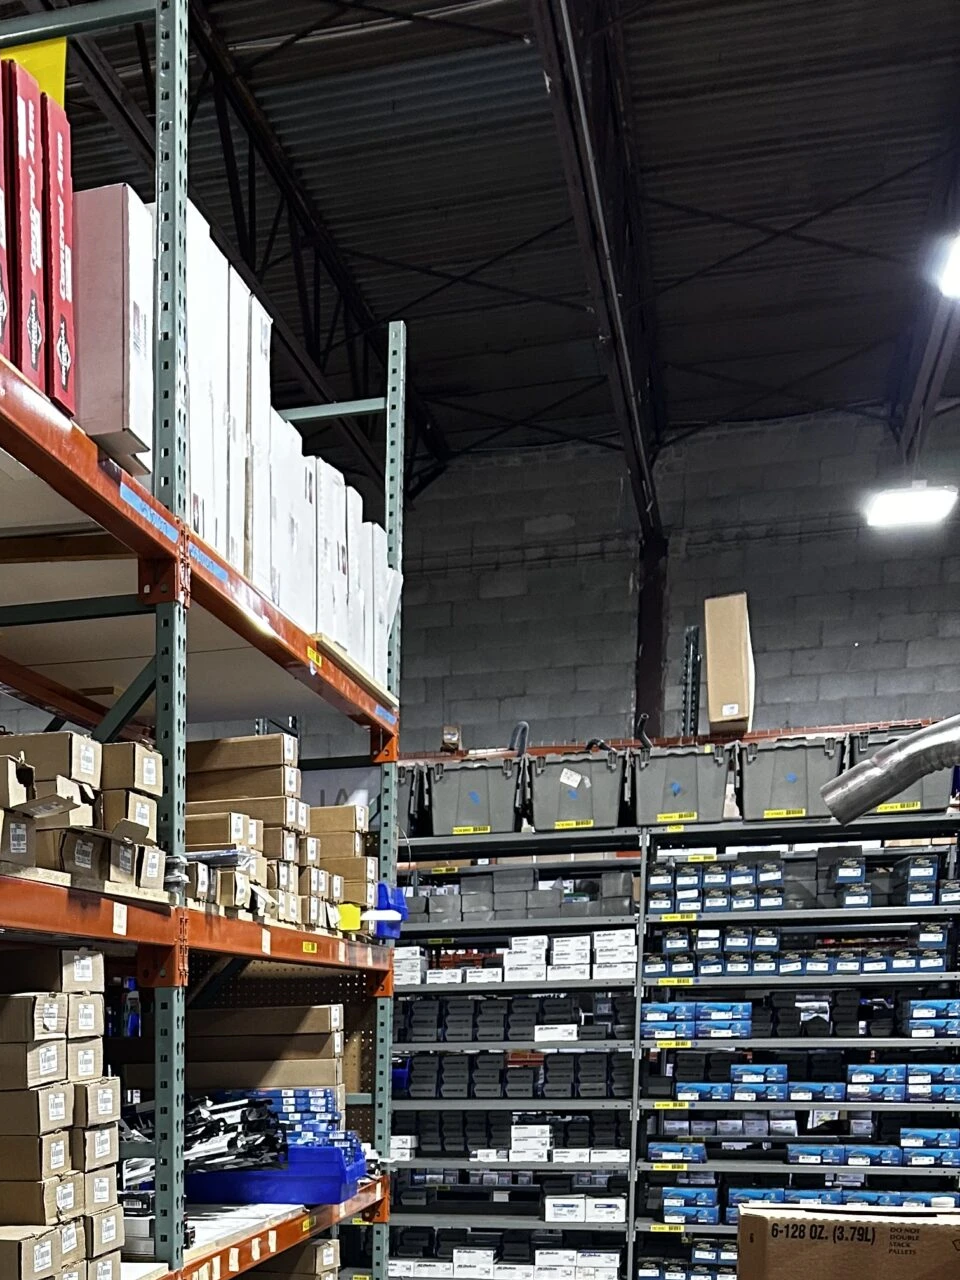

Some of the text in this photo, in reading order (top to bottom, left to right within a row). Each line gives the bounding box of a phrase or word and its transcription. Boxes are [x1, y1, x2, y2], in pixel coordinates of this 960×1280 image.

[26, 99, 36, 164] Arm
[56, 131, 65, 193] Arm
[771, 1222, 876, 1245] 6-128 OZ. (3.79L)
